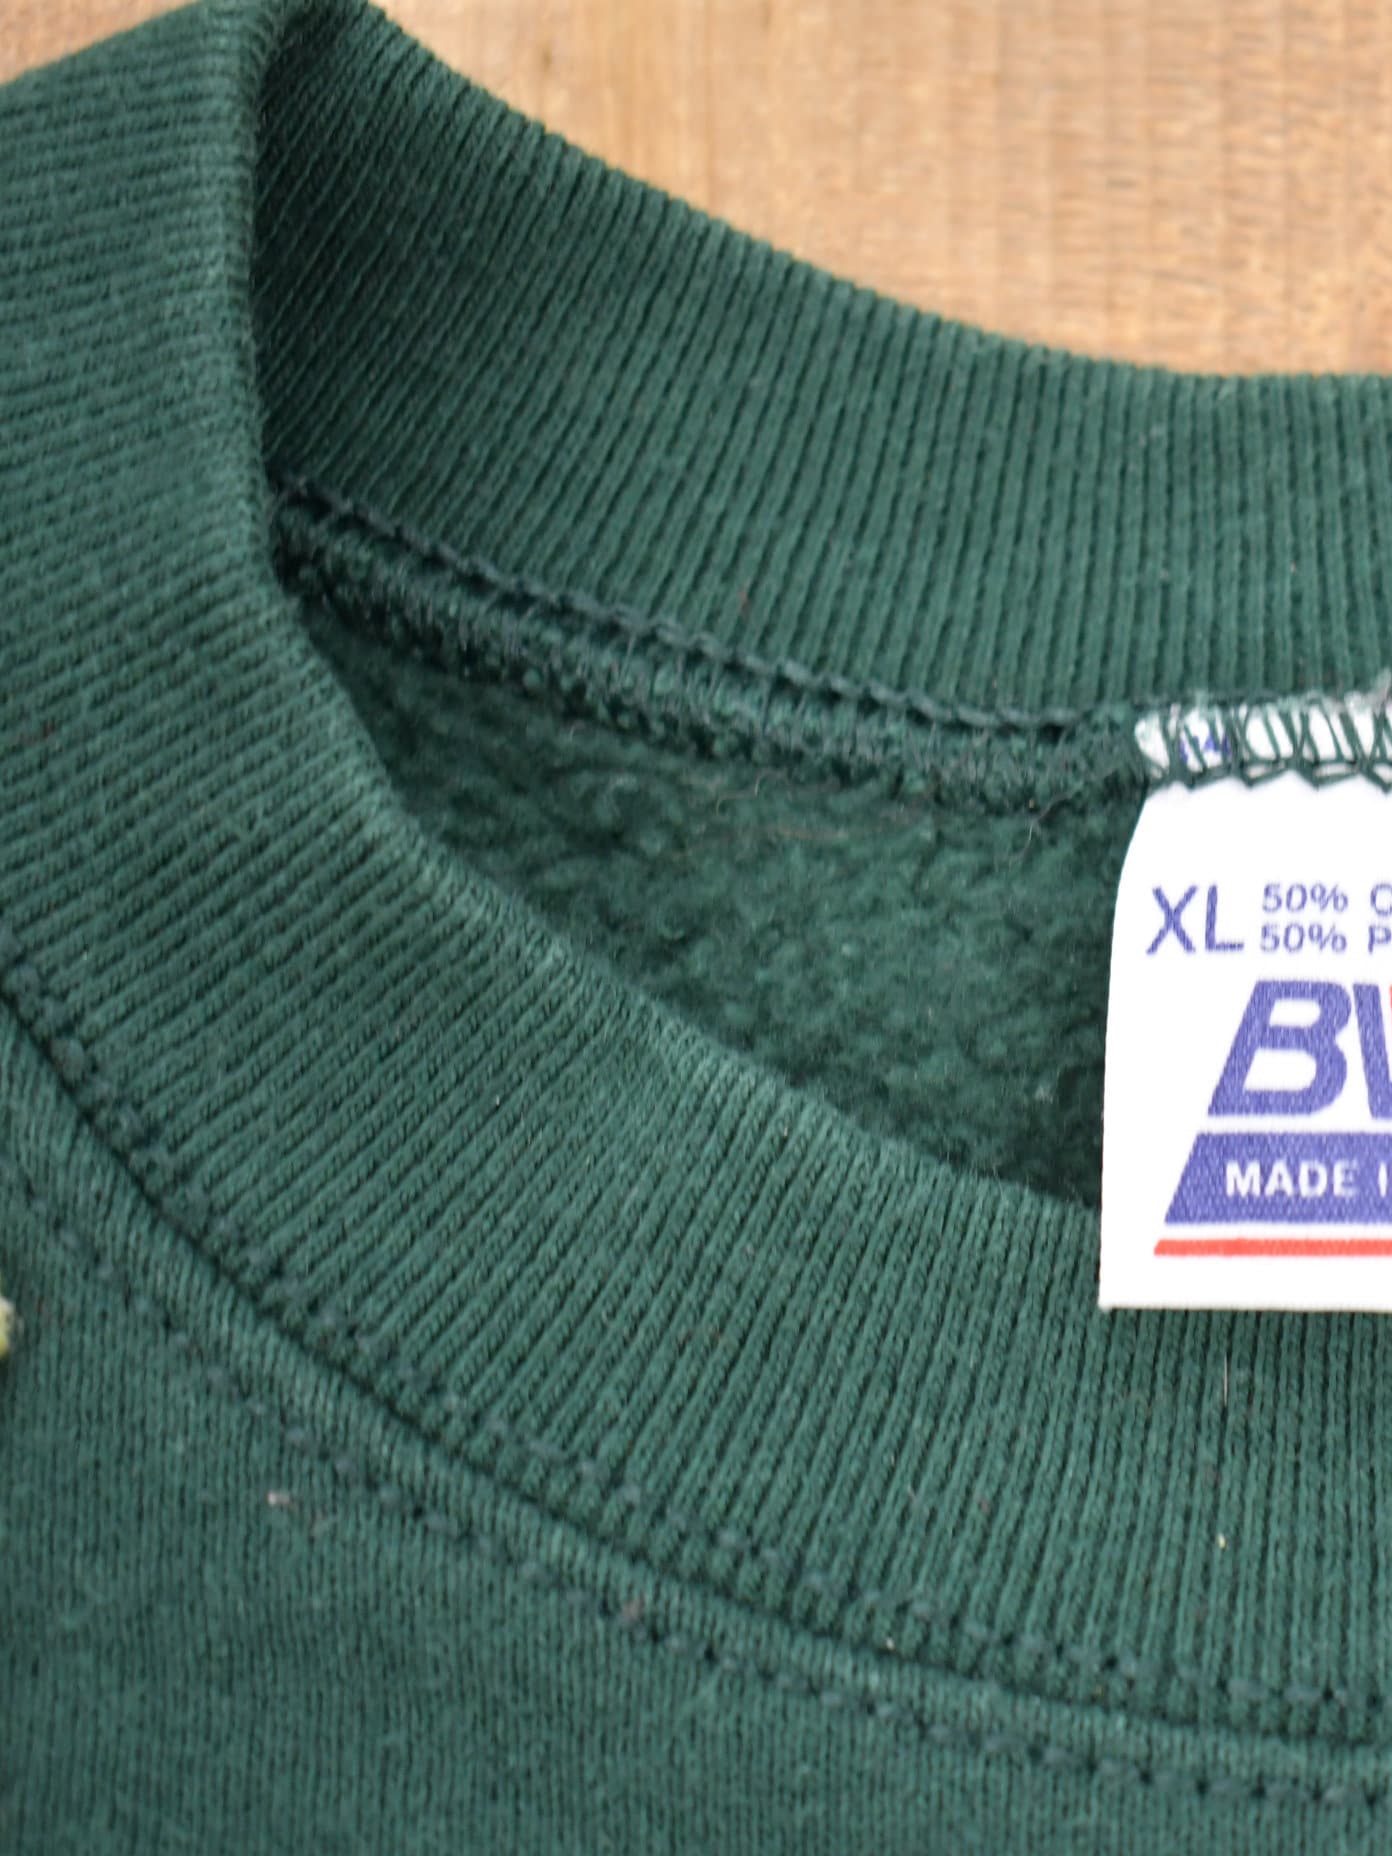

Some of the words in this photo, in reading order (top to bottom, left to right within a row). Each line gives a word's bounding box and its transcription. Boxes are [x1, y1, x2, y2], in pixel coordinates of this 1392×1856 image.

[1261, 883, 1348, 913] 50%
[1146, 884, 1244, 955] XL
[1260, 922, 1347, 954] 50%
[1225, 1160, 1358, 1198] MADE
